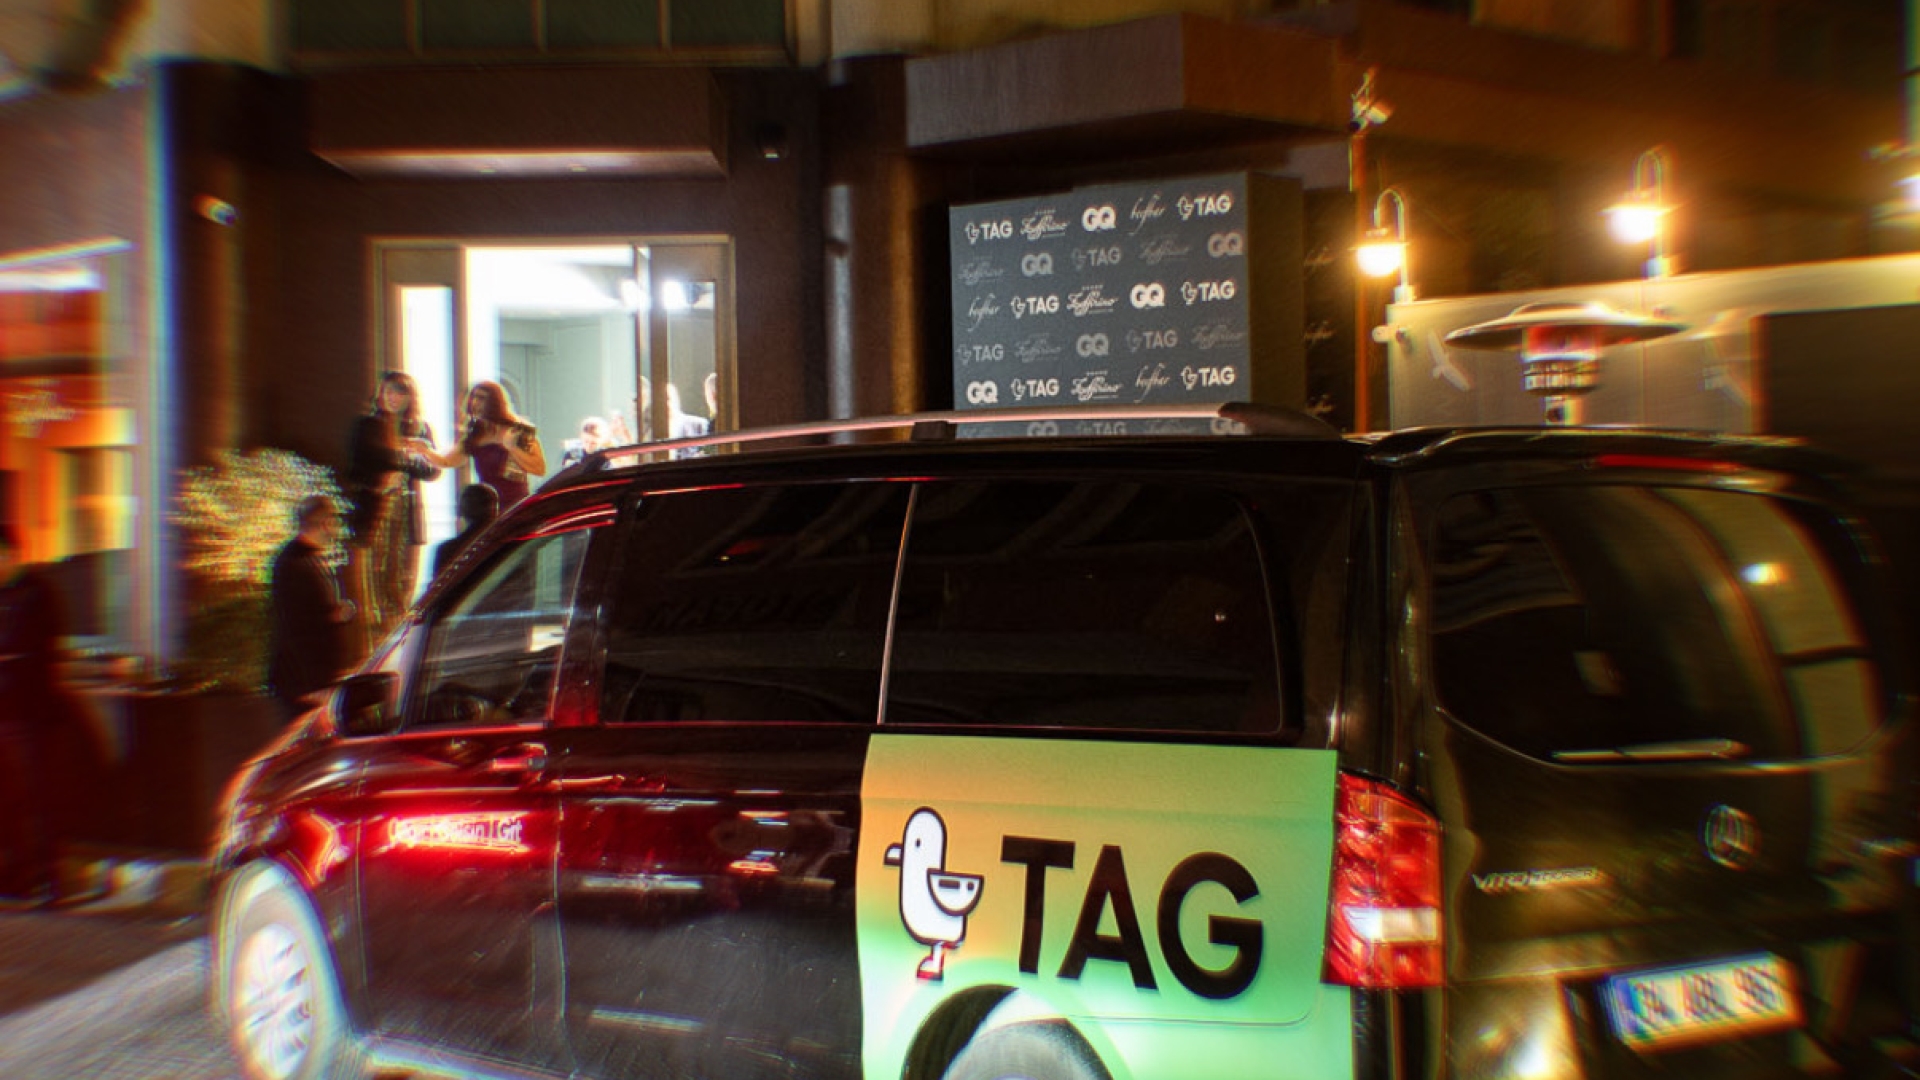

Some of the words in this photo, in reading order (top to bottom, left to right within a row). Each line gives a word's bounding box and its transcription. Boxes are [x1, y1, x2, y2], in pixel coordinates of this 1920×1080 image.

[1194, 193, 1232, 216] TAG
[980, 219, 1014, 240] TAG
[1082, 206, 1116, 231] GQ
[1207, 232, 1244, 258] GQ
[1021, 252, 1053, 277] GQ
[1088, 247, 1122, 266] TAG
[1129, 283, 1165, 309] GQ
[1198, 280, 1236, 301] TAG
[1026, 295, 1060, 315] TAG
[1076, 332, 1109, 357] GQ
[1142, 329, 1178, 349] TAG
[972, 343, 1004, 362] TAG
[1198, 365, 1236, 387] TAG
[967, 380, 998, 404] GQ
[1026, 378, 1060, 398] TAG
[1001, 834, 1263, 999] TAG
